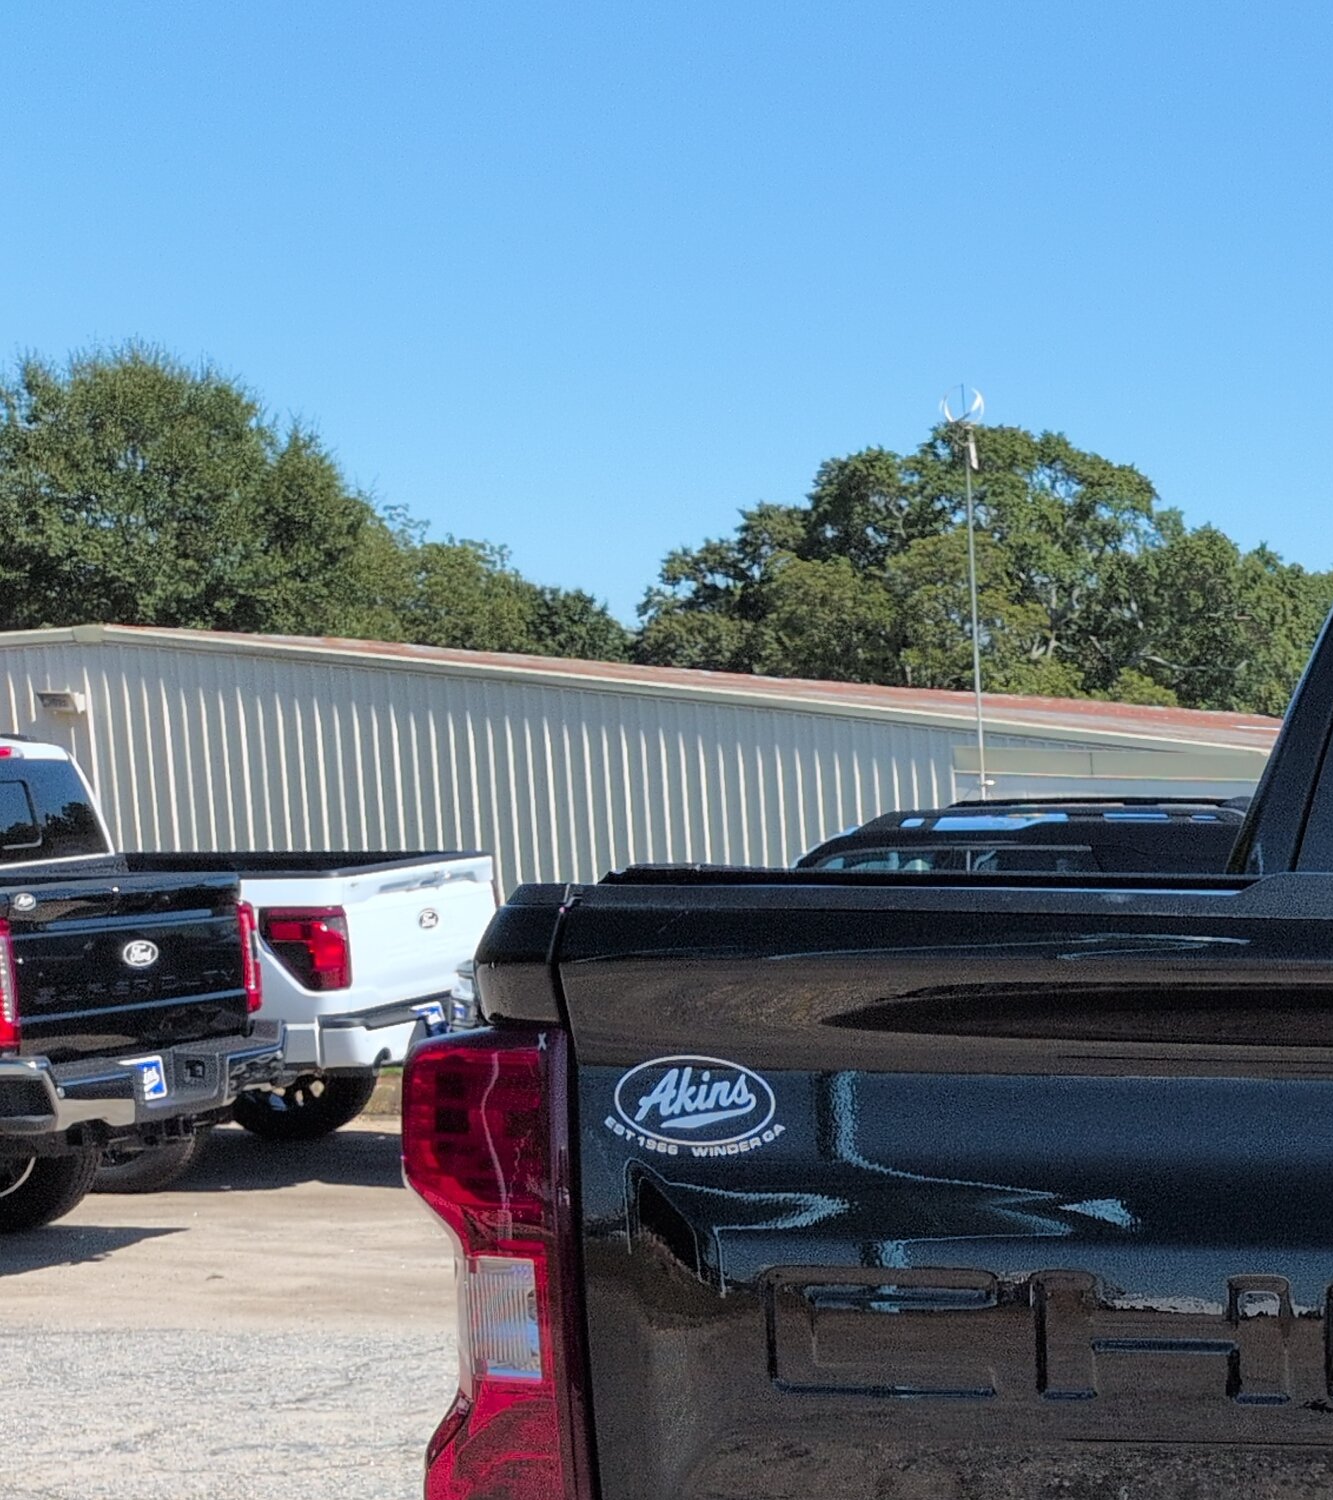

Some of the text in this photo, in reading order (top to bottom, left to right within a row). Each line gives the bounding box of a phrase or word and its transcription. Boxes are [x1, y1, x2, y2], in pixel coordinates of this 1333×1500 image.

[634, 1066, 756, 1128] Akins
[604, 1115, 636, 1141] EST
[691, 1137, 762, 1158] WINDER
[762, 1123, 786, 1143] GA
